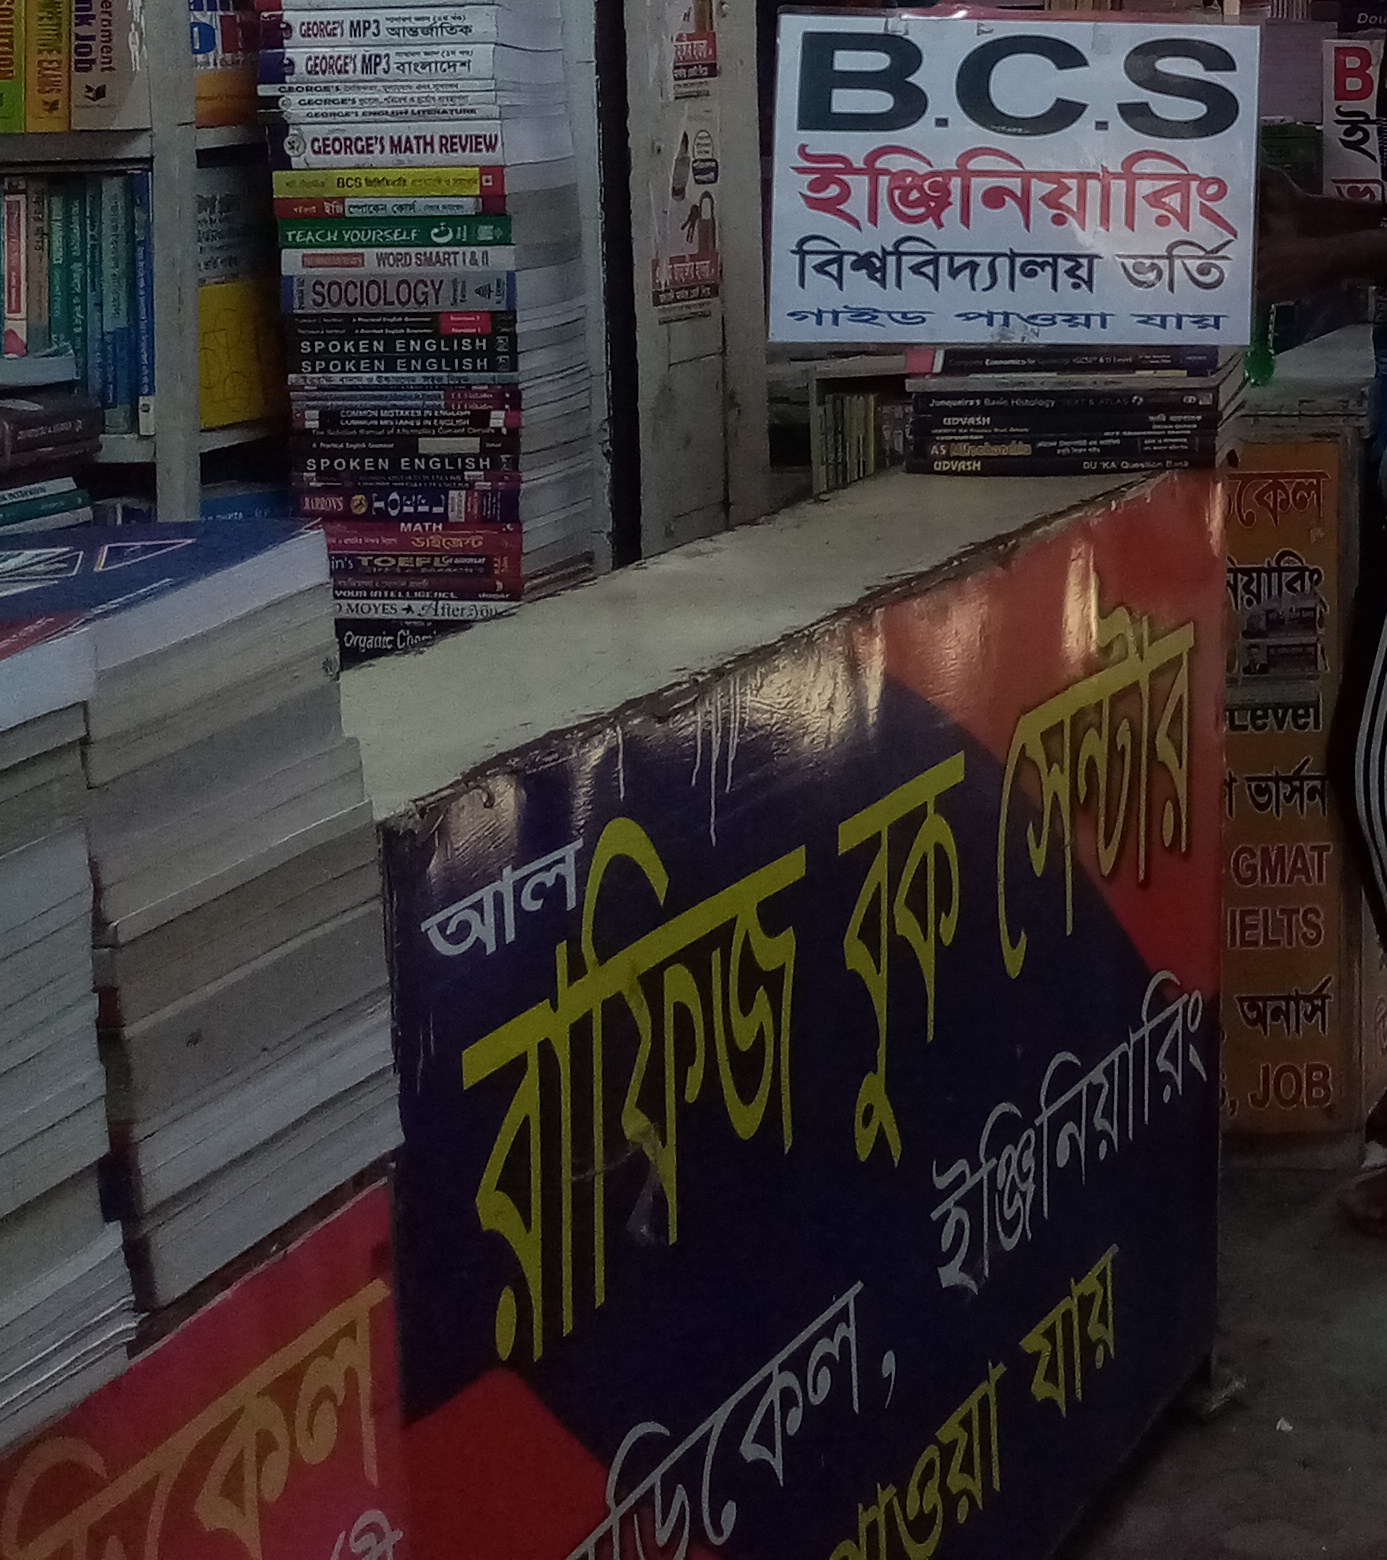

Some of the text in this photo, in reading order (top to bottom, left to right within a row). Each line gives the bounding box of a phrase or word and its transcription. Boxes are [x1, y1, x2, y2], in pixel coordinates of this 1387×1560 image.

[349, 21, 381, 38] MP3
[74, 32, 97, 73] Job
[304, 54, 358, 76] GEORGE'S
[361, 52, 391, 75] MP3
[797, 31, 1240, 140] B.C.S
[310, 132, 499, 157] GEORGE'S MATH REVIEW
[791, 144, 1239, 238] ইঞ্জিনিয়ারিং
[286, 227, 421, 244] TEACH YOURSELF
[375, 251, 461, 268] WORD SMART
[791, 234, 1235, 295] বিশ্ববিদ্যালয় ভর্তি
[311, 278, 445, 309] SOCIOLOGY
[786, 307, 1230, 332] গাইড পাওয়া যায়
[299, 337, 488, 355] SPOKEN ENGLISH
[300, 356, 489, 373] SPOKEN ENGLISH
[305, 455, 492, 472] SPOKEN ENGLISH
[399, 521, 444, 533] MATH
[346, 603, 398, 615] MOYES
[343, 630, 394, 651] Organic
[999, 605, 1195, 980] সেন্টার
[1231, 843, 1333, 889] GMAT
[1227, 905, 1325, 951] IELTS
[839, 751, 966, 1166] বুক
[1236, 976, 1335, 1039] অনার্স
[421, 816, 806, 1363] আল রাফিজ
[1249, 1062, 1334, 1112] JOB
[1019, 1242, 1120, 1418] যায়
